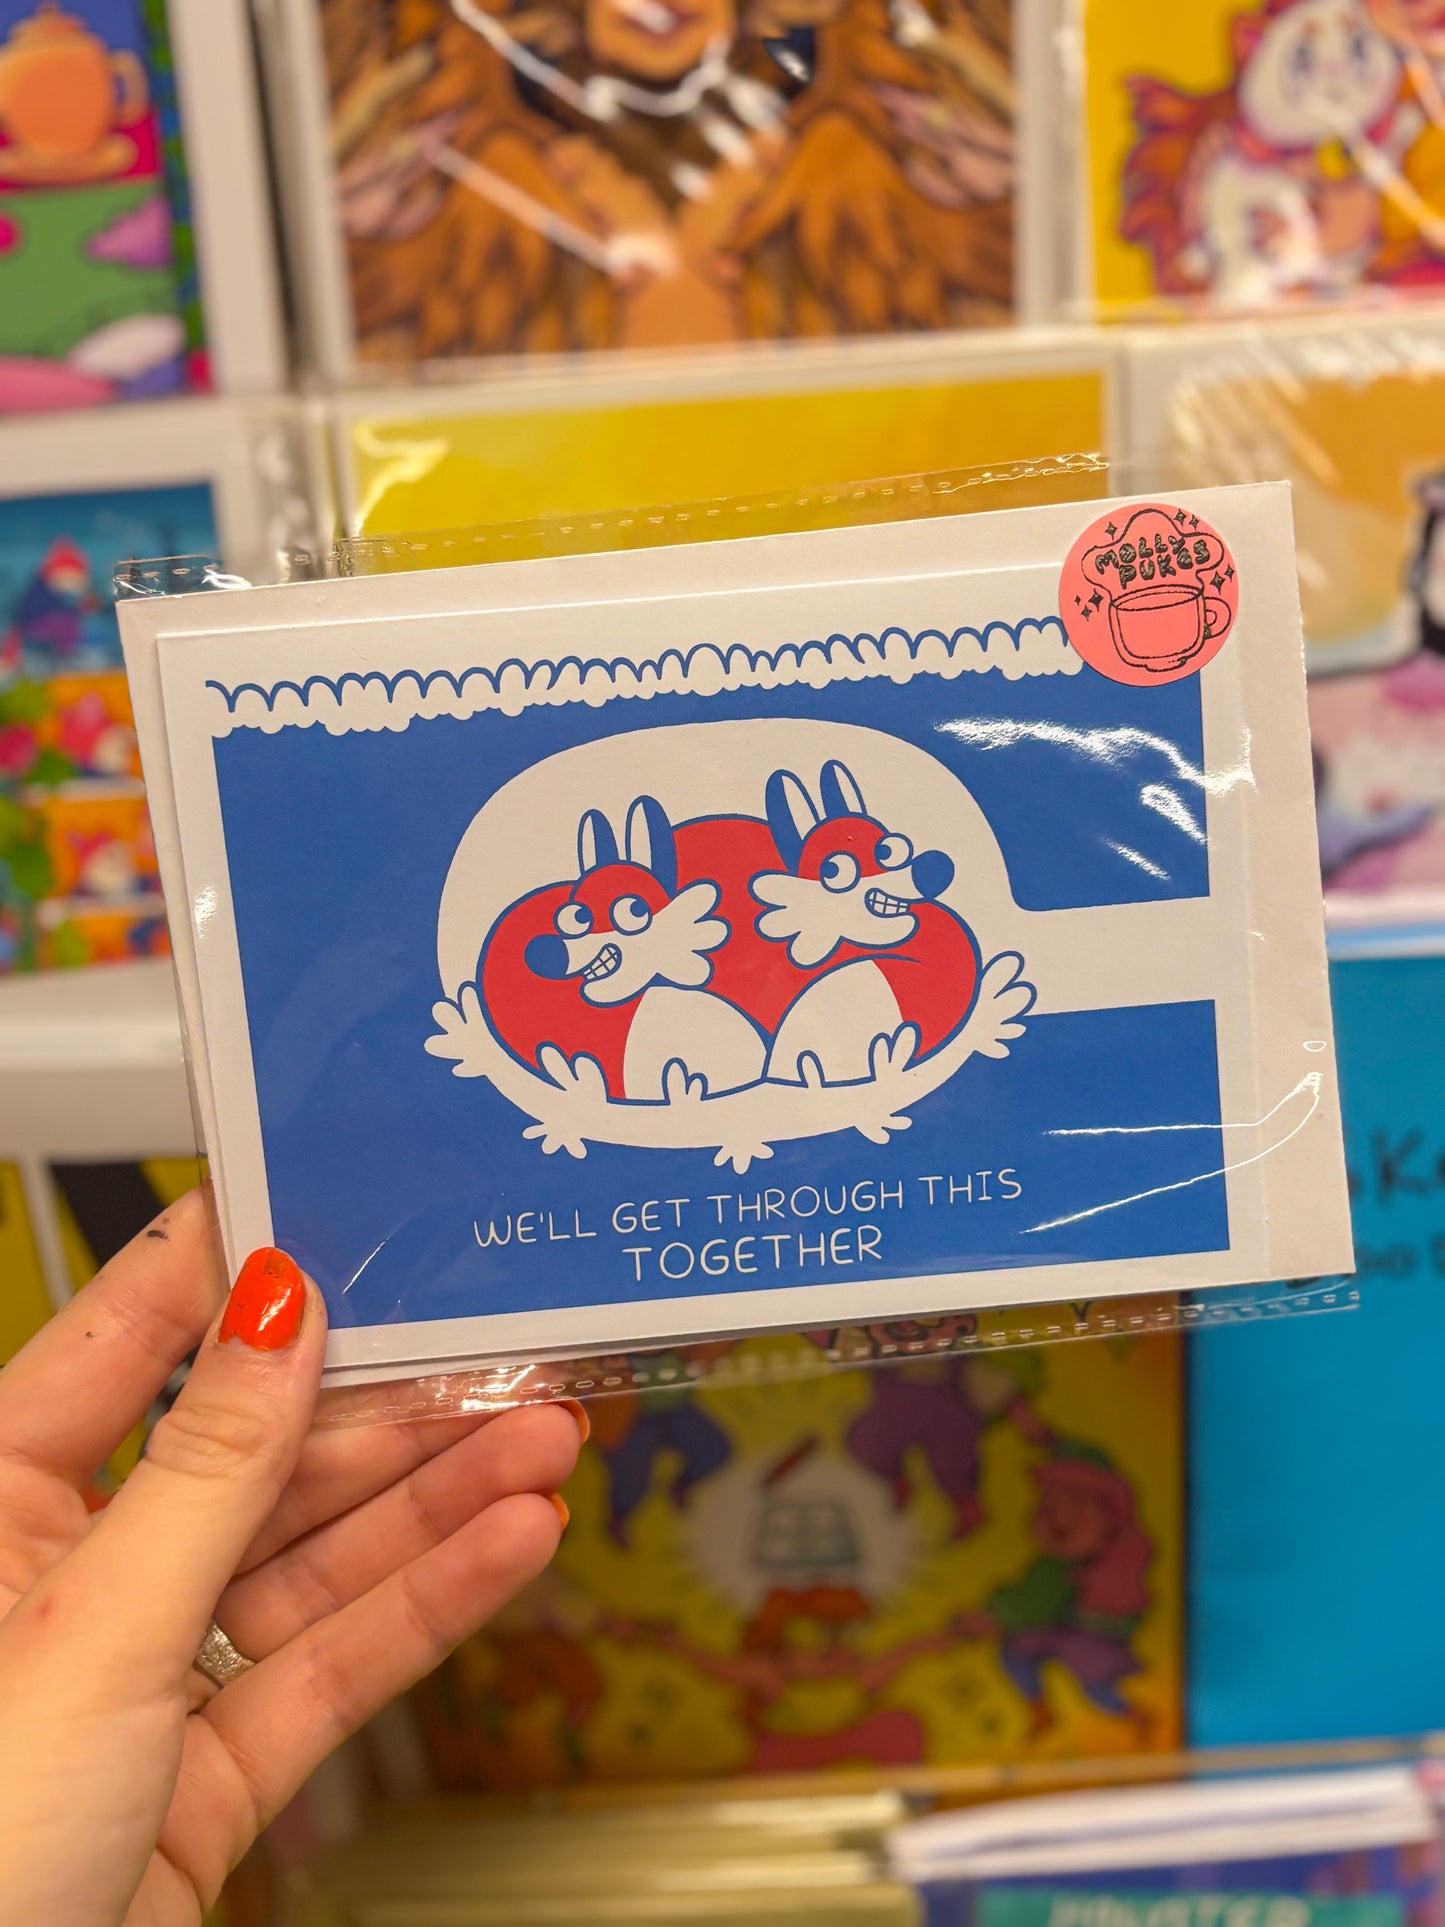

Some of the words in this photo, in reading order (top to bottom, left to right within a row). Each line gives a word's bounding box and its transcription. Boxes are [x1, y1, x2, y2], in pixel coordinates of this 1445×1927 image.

[1095, 533, 1185, 575] MOLLY
[473, 1208, 597, 1248] WE'LL
[611, 1197, 691, 1234] GET
[706, 1180, 904, 1224] THROUGH
[918, 1168, 1022, 1205] THIS
[622, 1224, 883, 1282] TOGETHER
